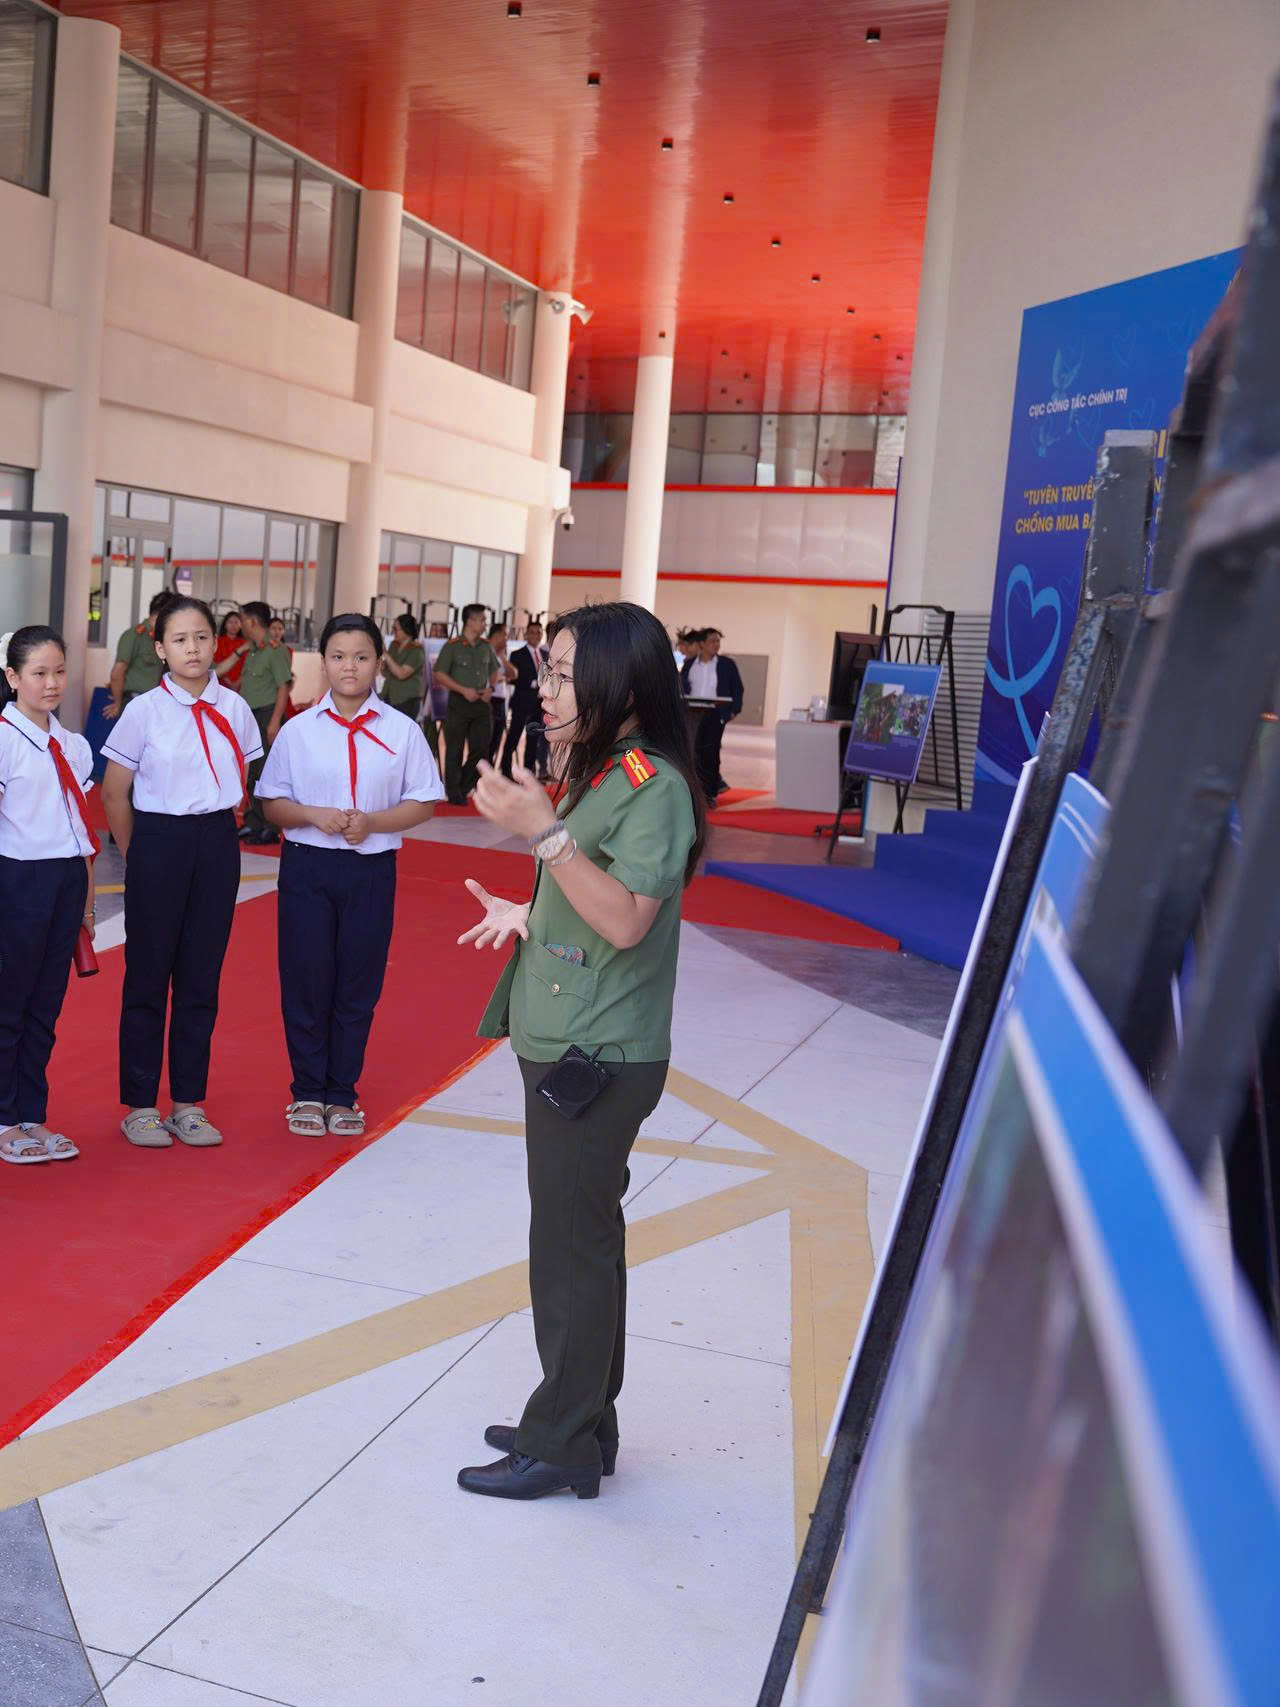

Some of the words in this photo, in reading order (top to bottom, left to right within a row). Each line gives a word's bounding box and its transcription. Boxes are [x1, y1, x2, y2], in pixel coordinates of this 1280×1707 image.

[1029, 404, 1045, 419] CỤC
[1047, 398, 1070, 415] CÔNG
[1071, 393, 1086, 410] TÁC
[1088, 390, 1113, 406] CHÍNH
[1115, 387, 1128, 404] TRỊ
[1015, 511, 1054, 534] CHỐNG
[1056, 514, 1079, 531] MUA
